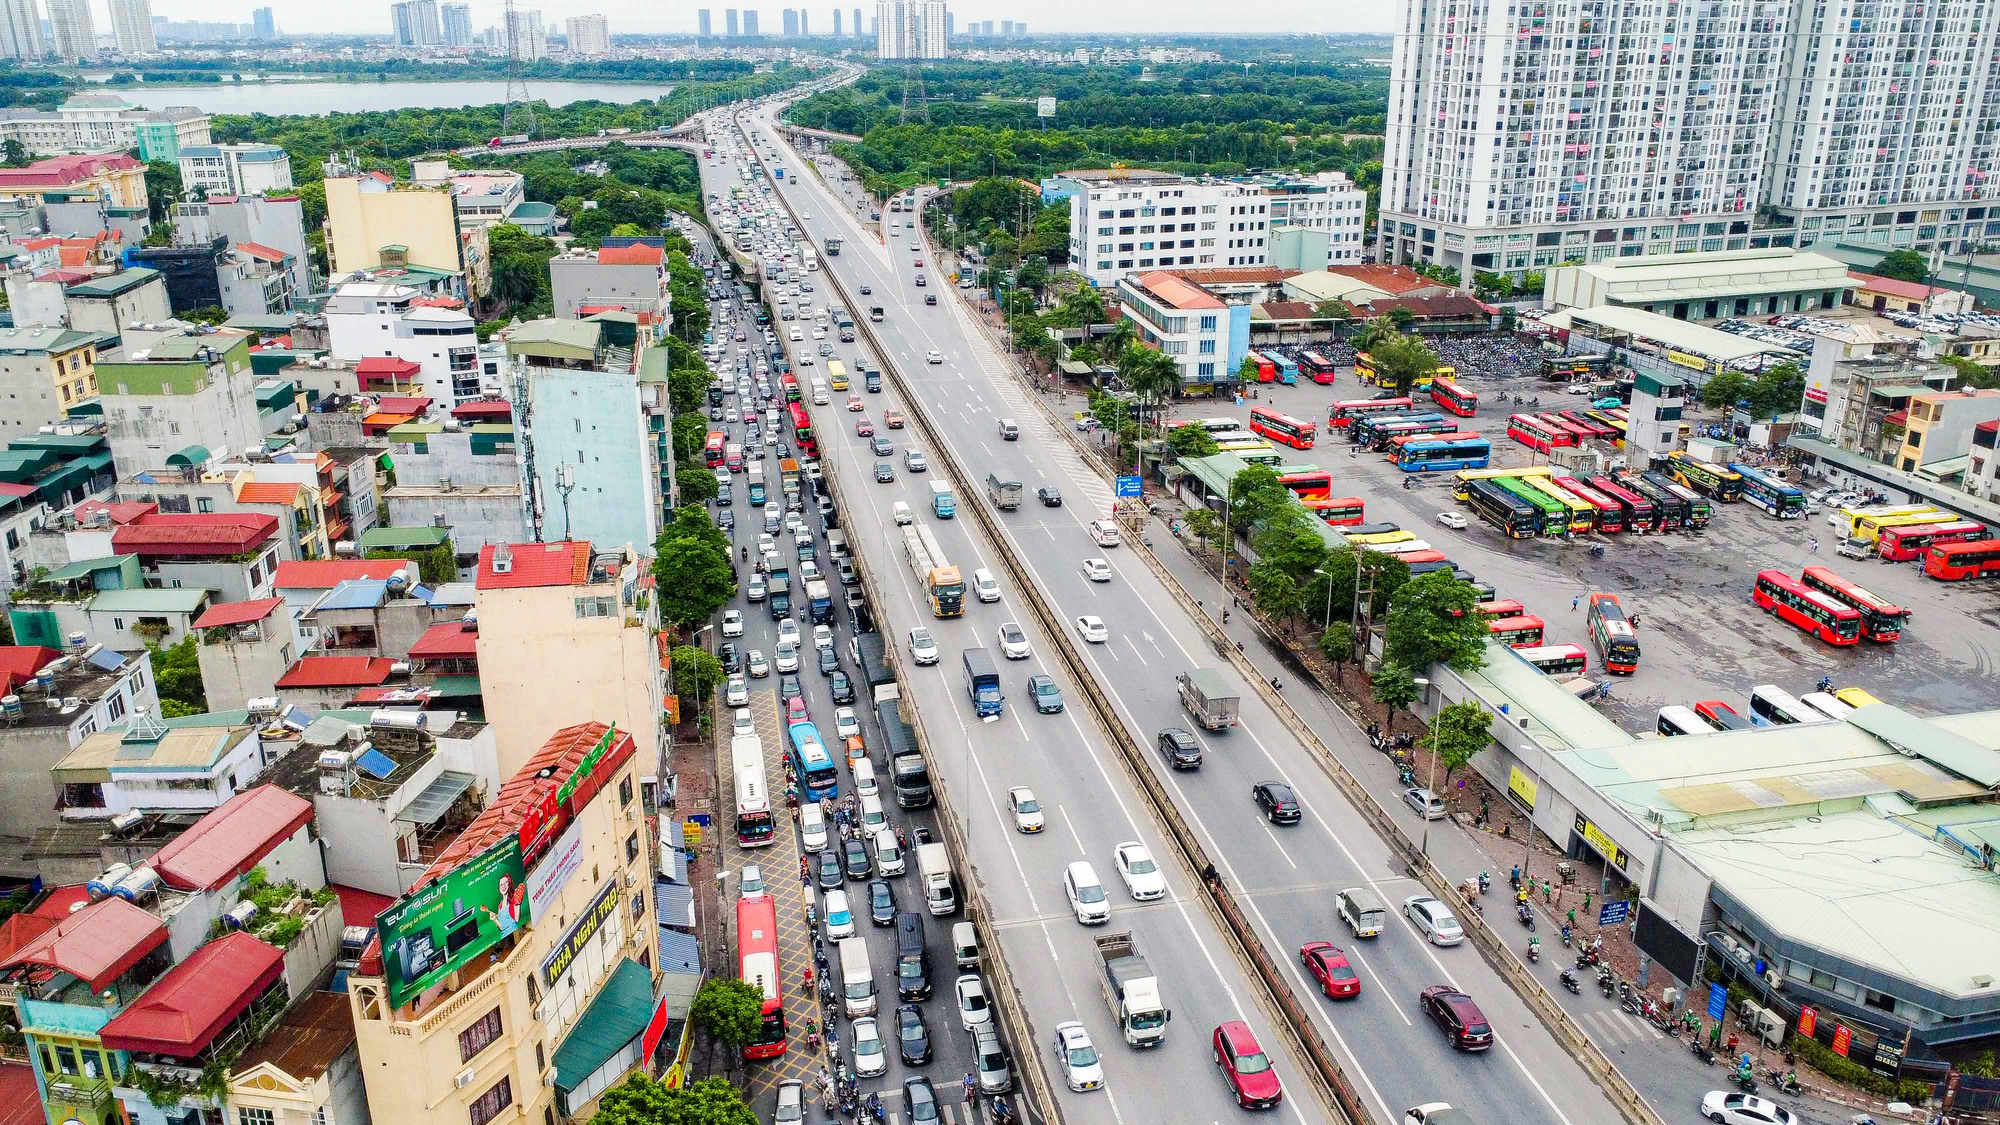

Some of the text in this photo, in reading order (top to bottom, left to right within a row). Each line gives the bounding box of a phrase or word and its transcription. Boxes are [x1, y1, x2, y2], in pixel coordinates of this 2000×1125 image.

[549, 944, 572, 982] NHÀ
[573, 910, 598, 952] NGHỈ
[599, 887, 618, 919] TRỌ
